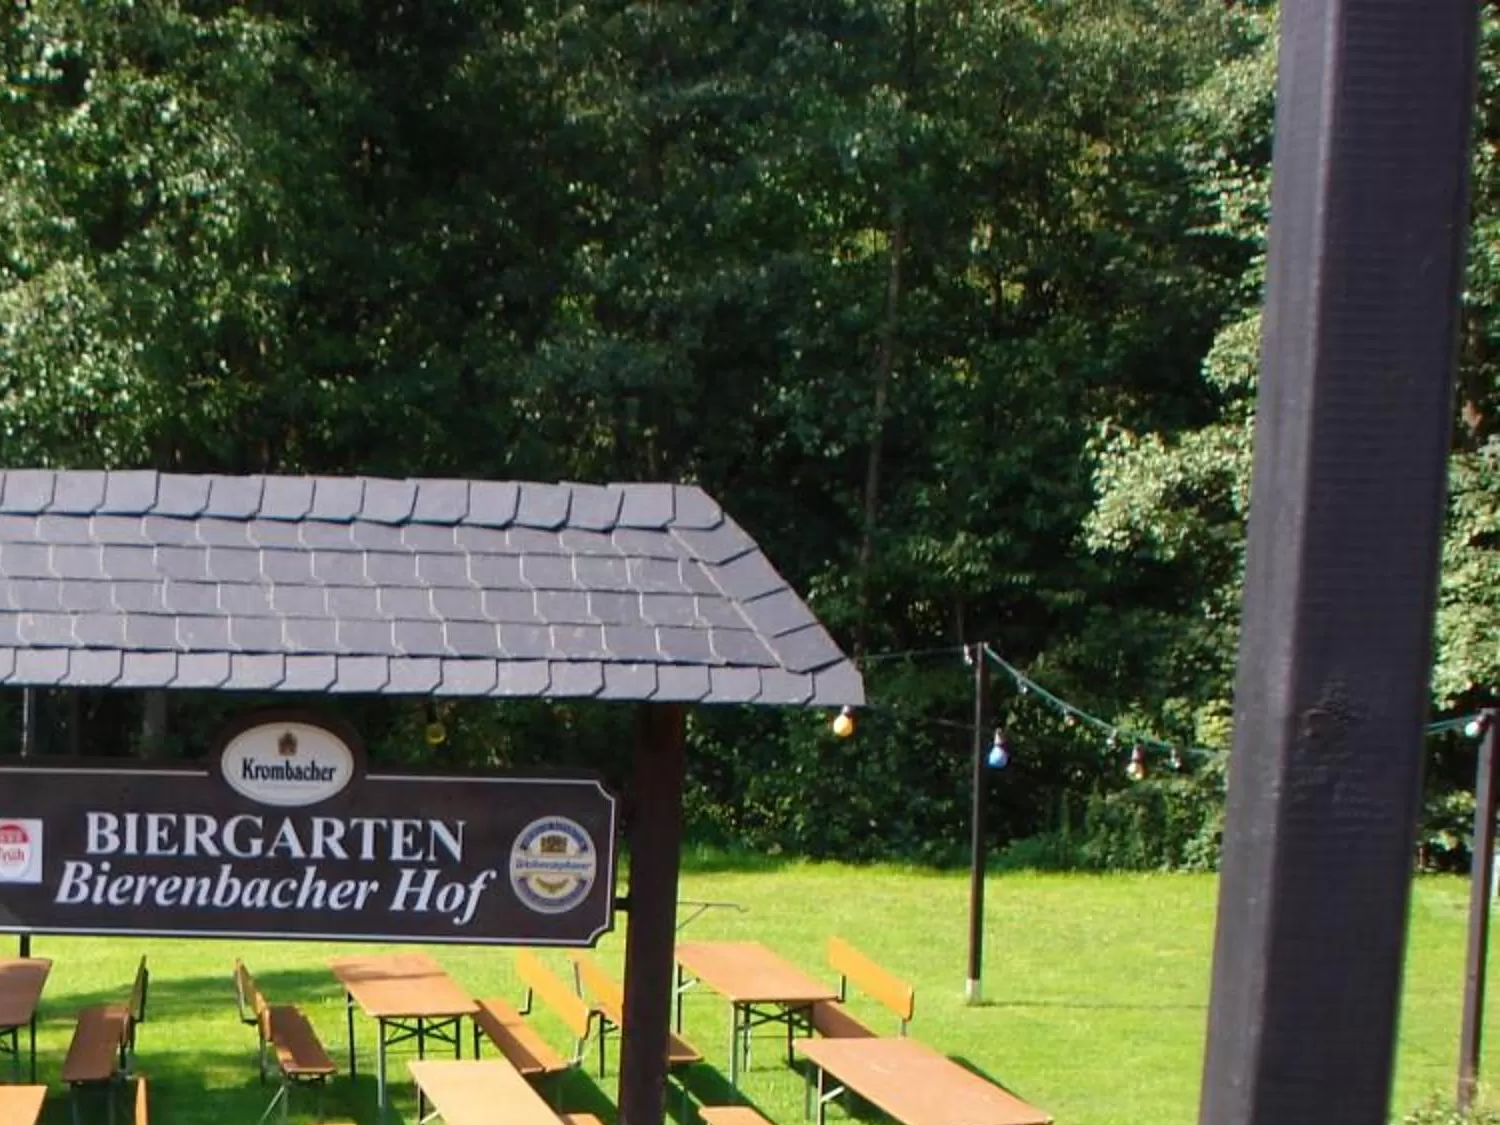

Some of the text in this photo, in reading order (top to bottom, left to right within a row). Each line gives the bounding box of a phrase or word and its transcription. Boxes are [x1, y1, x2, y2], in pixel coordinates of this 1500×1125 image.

[242, 757, 336, 782] Krombacher
[85, 811, 465, 861] BIERGARTEN
[55, 860, 378, 912] Bierenbacher
[389, 868, 496, 925] Hof
